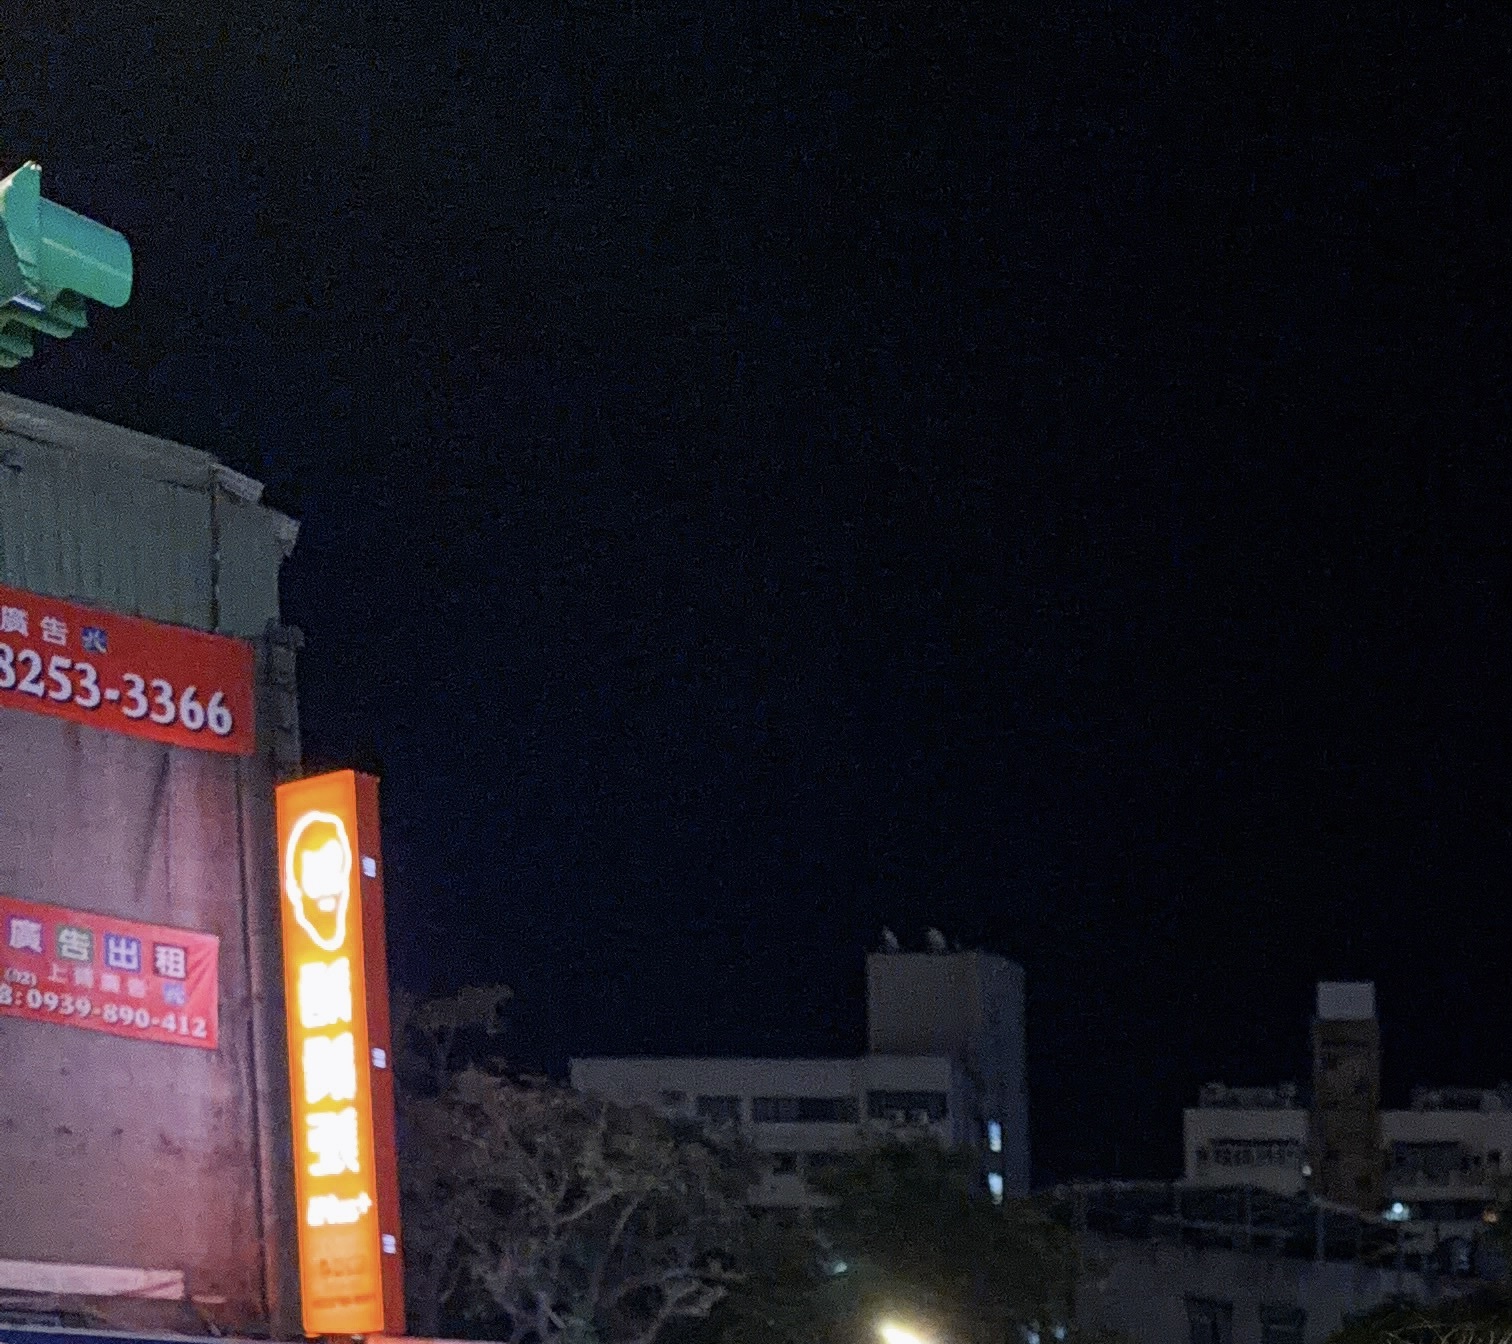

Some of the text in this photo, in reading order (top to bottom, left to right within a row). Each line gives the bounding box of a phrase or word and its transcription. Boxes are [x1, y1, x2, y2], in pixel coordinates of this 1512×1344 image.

[0, 642, 233, 736] 8253-3366
[7, 916, 188, 980] 廣告出租
